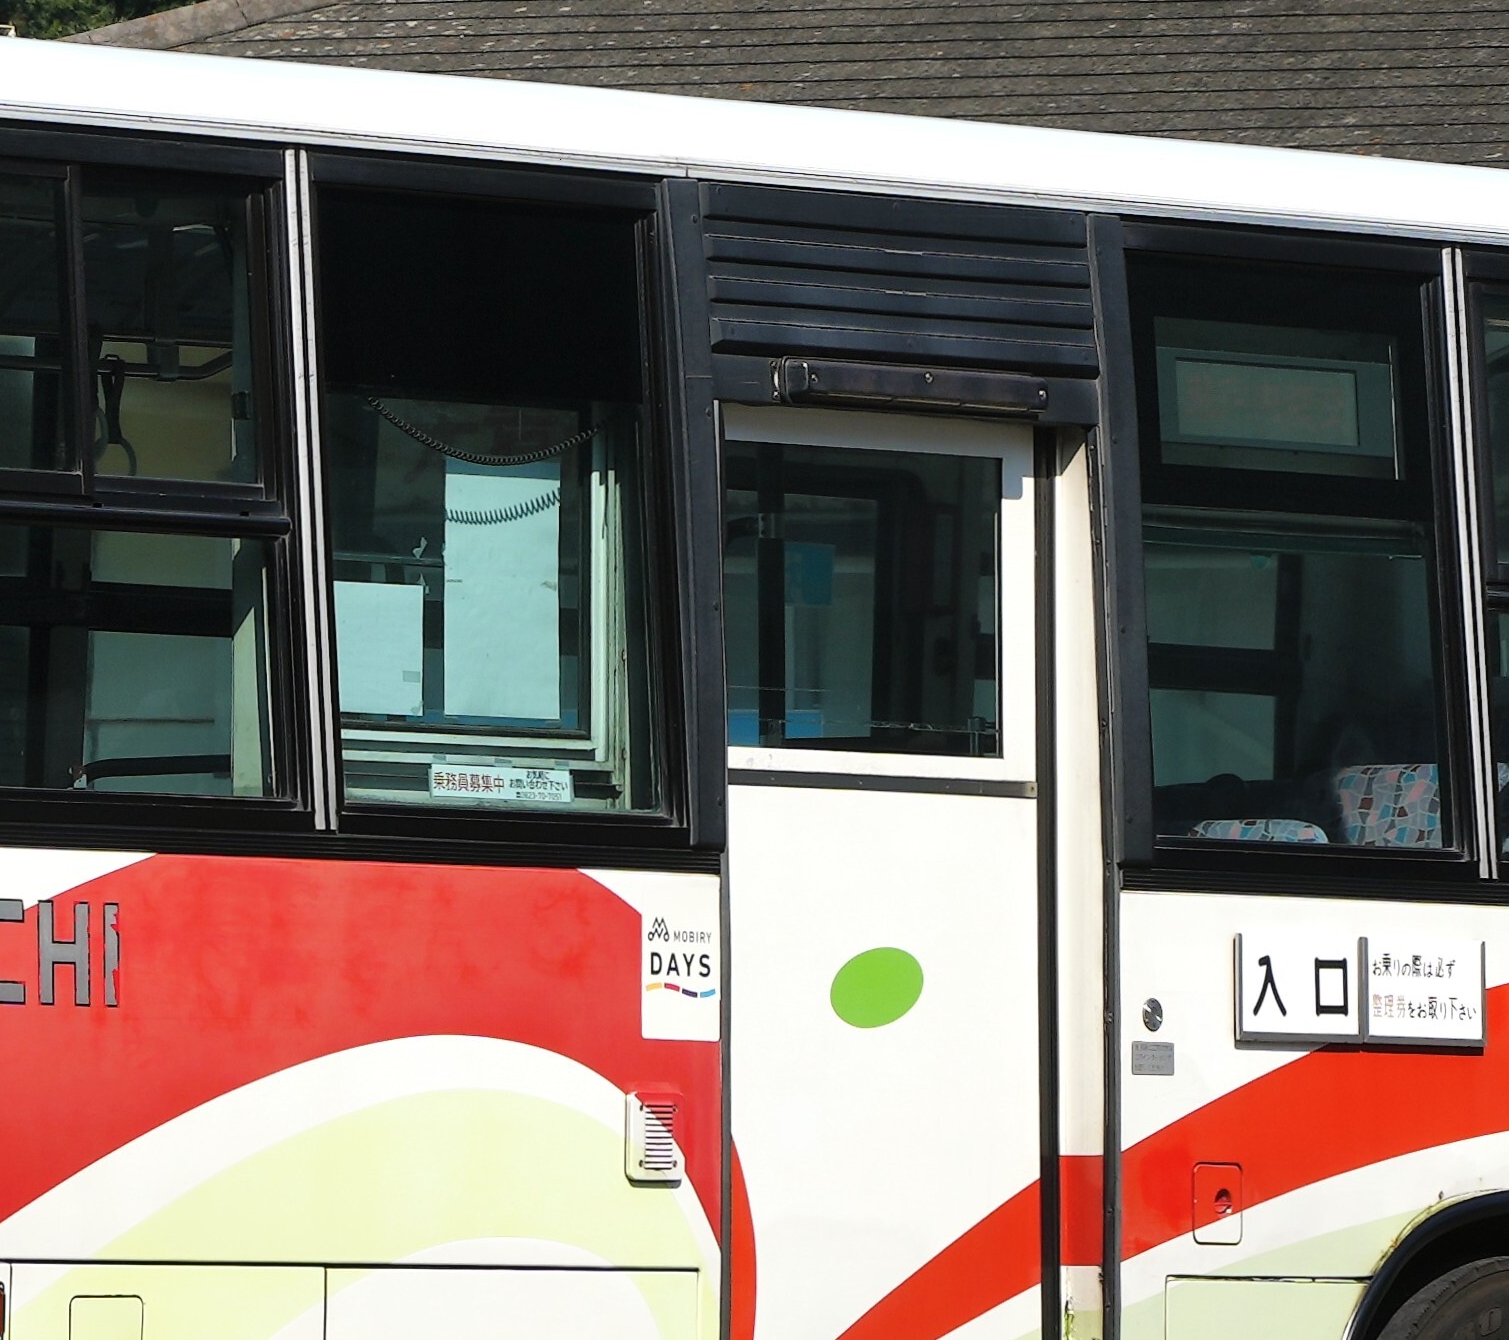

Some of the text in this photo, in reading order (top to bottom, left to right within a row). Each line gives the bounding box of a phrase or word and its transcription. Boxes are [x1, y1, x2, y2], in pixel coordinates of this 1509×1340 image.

[673, 930, 712, 944] MOBIRY
[650, 951, 711, 978] DAYS
[1372, 953, 1456, 978] お乗りの際は必ず
[1253, 954, 1348, 1017] 入口
[1372, 993, 1477, 1021] 整理券をお取り下さい
